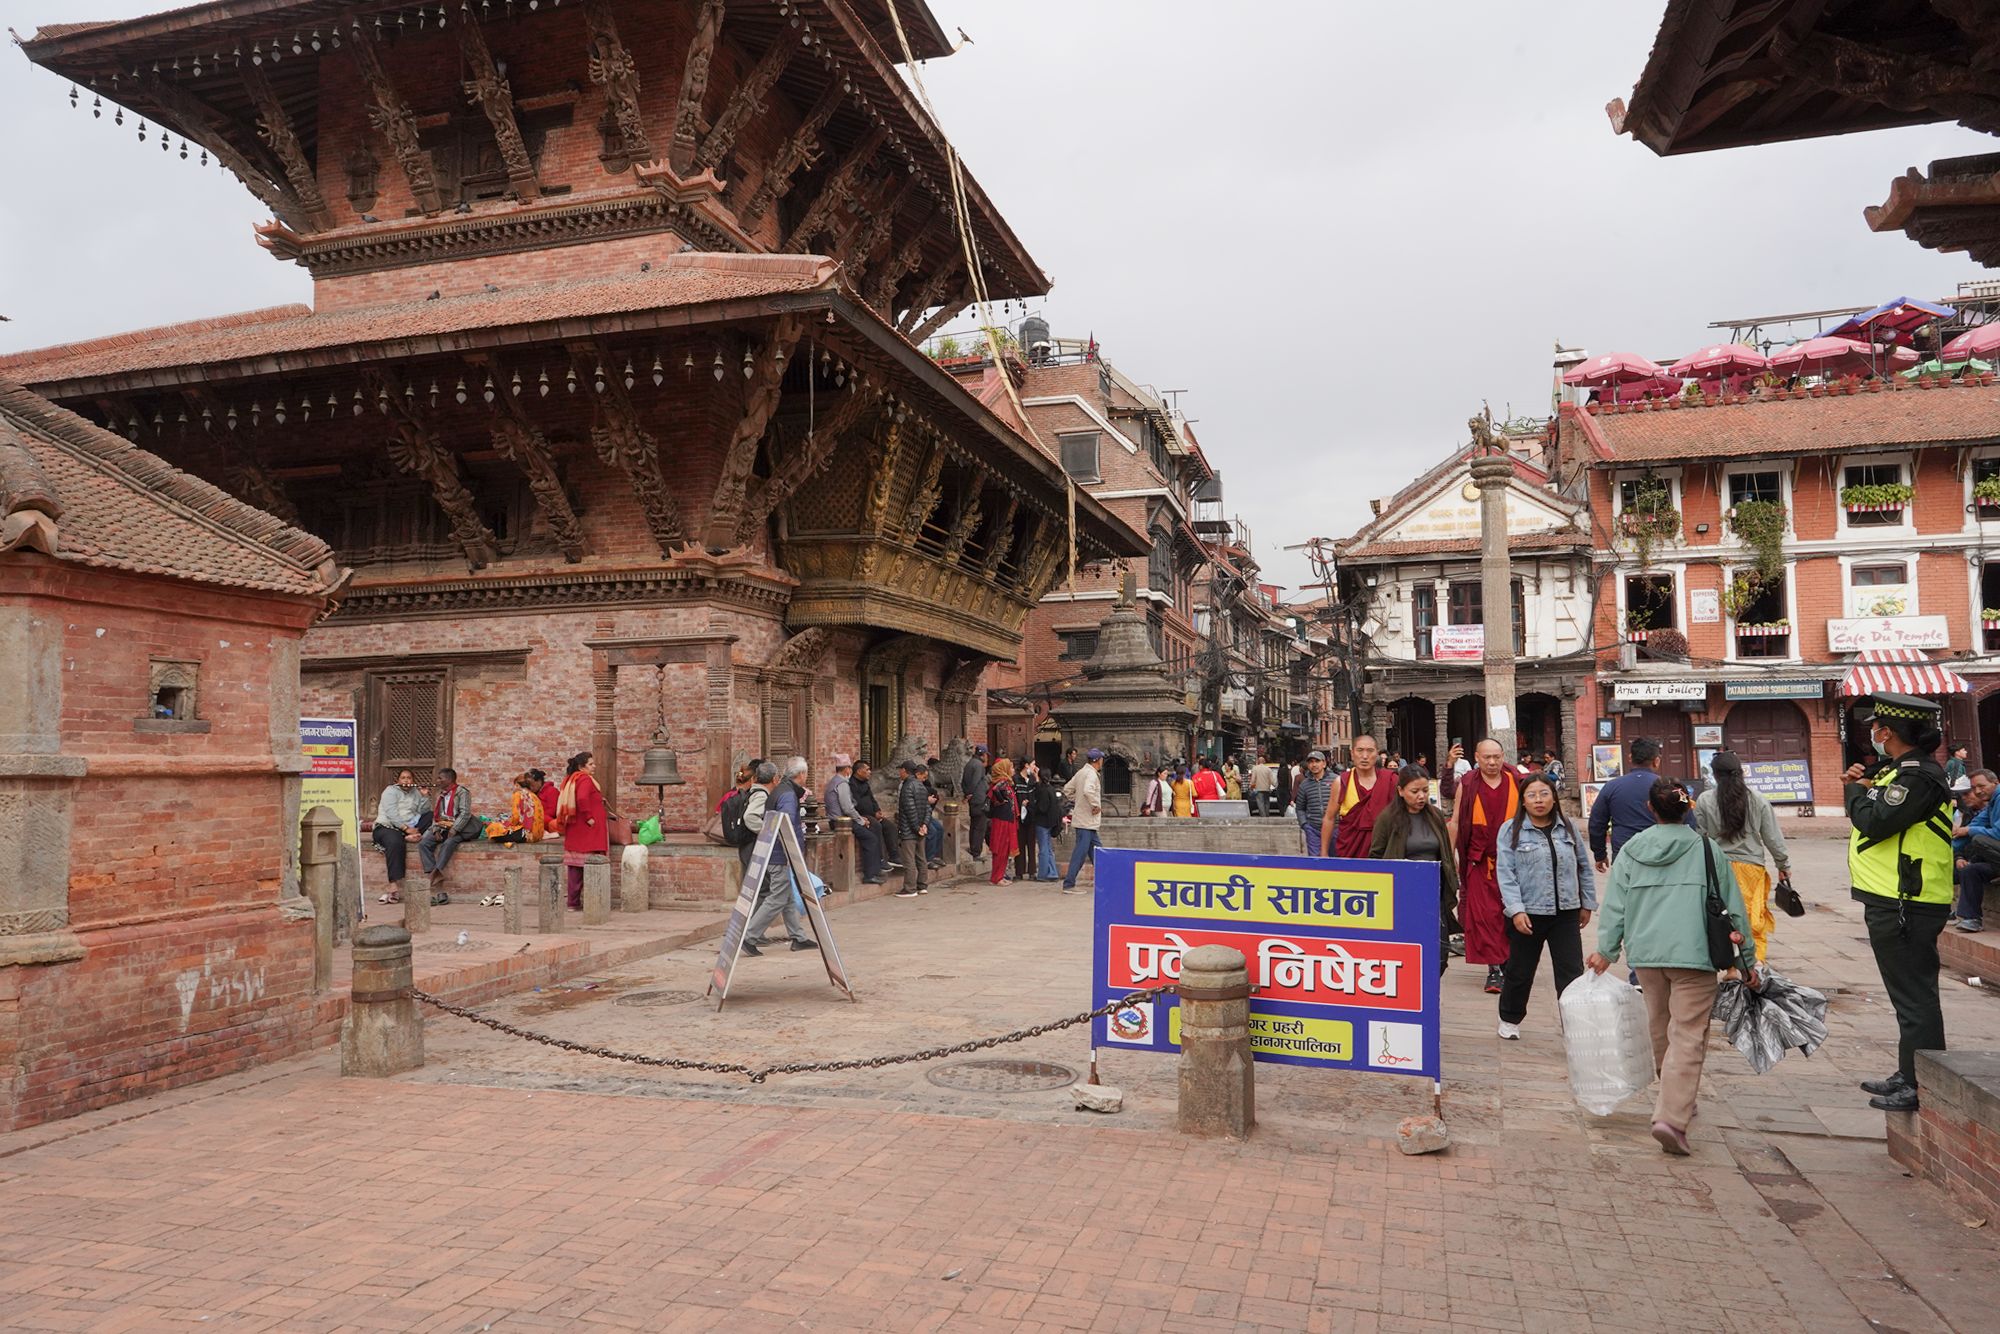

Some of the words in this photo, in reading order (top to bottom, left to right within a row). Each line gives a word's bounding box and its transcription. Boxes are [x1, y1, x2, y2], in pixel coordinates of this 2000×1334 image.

[1834, 633, 1866, 645] Cafe
[1871, 631, 1891, 642] Du
[1895, 629, 1943, 642] Temple
[1617, 685, 1639, 696] Arjun
[1645, 685, 1661, 694] Art
[1667, 684, 1704, 697] Gallery
[1727, 686, 1746, 696] PATAN
[1147, 874, 1255, 912] सवारी
[1267, 885, 1379, 918] साधन
[1126, 933, 1200, 984] प्रवे
[1257, 938, 1403, 998] निषेध
[1248, 1019, 1268, 1032] गर
[1272, 1019, 1305, 1035] प्रहरी
[1249, 1034, 1342, 1054] हानगरपालिका
